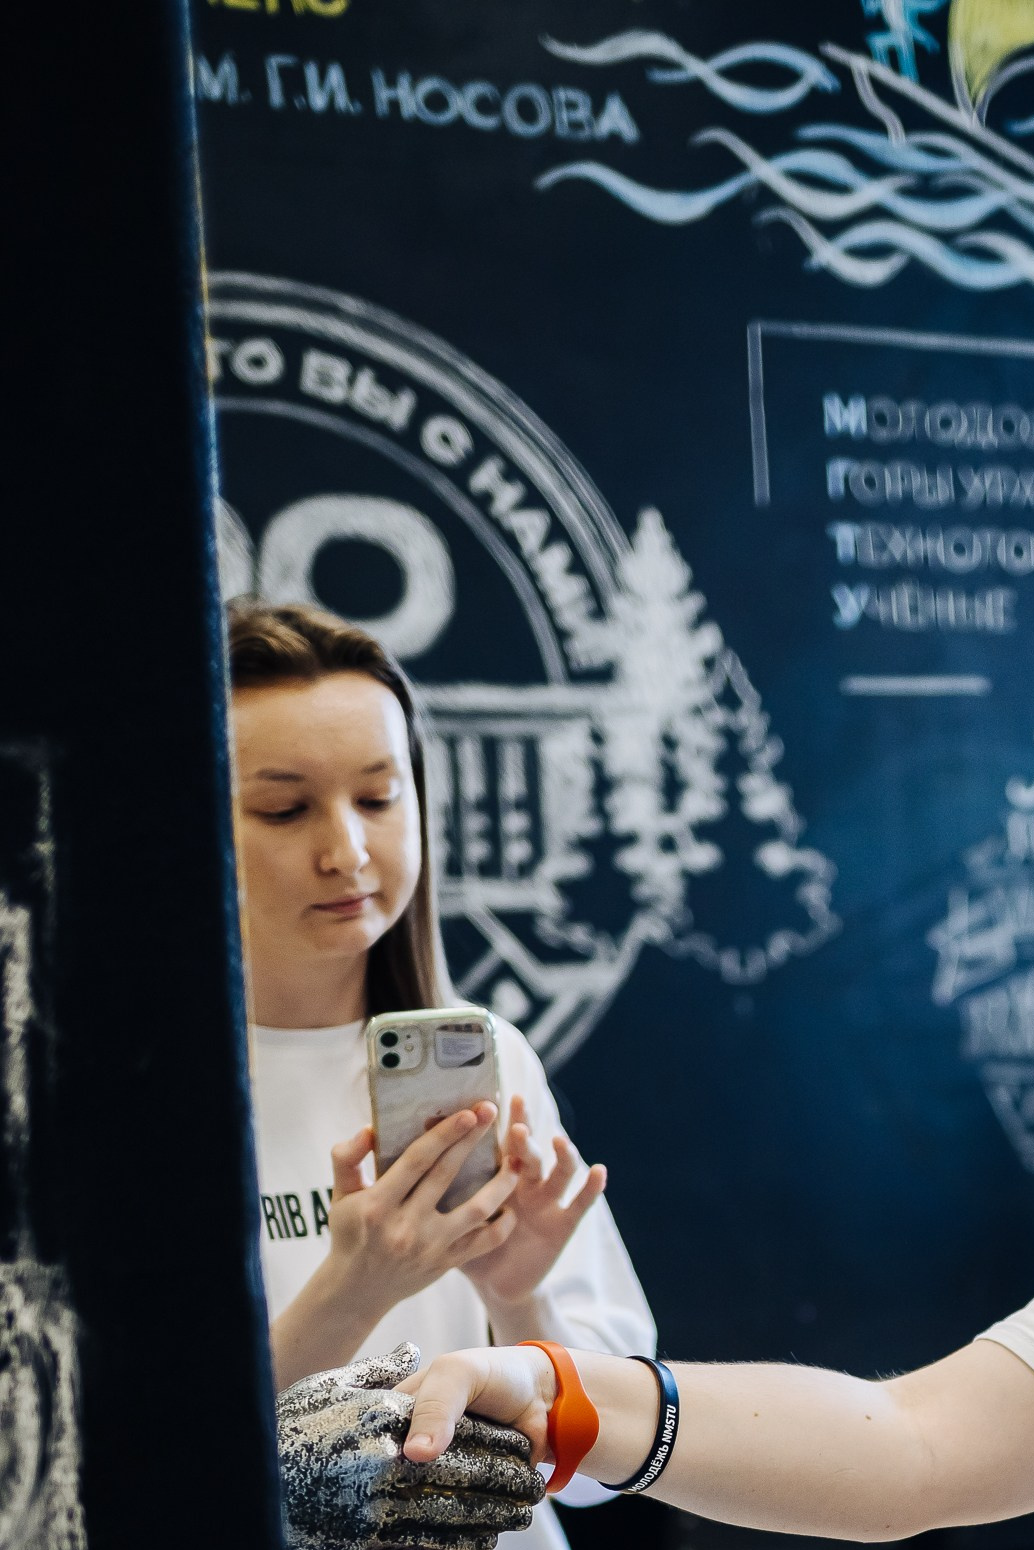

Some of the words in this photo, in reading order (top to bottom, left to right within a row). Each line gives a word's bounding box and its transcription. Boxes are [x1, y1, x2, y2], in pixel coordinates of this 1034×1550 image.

[370, 66, 642, 145] НОСОВА
[629, 1444, 669, 1493] МОЛОДЁЖЬ
[661, 1404, 677, 1444] NMSTU
